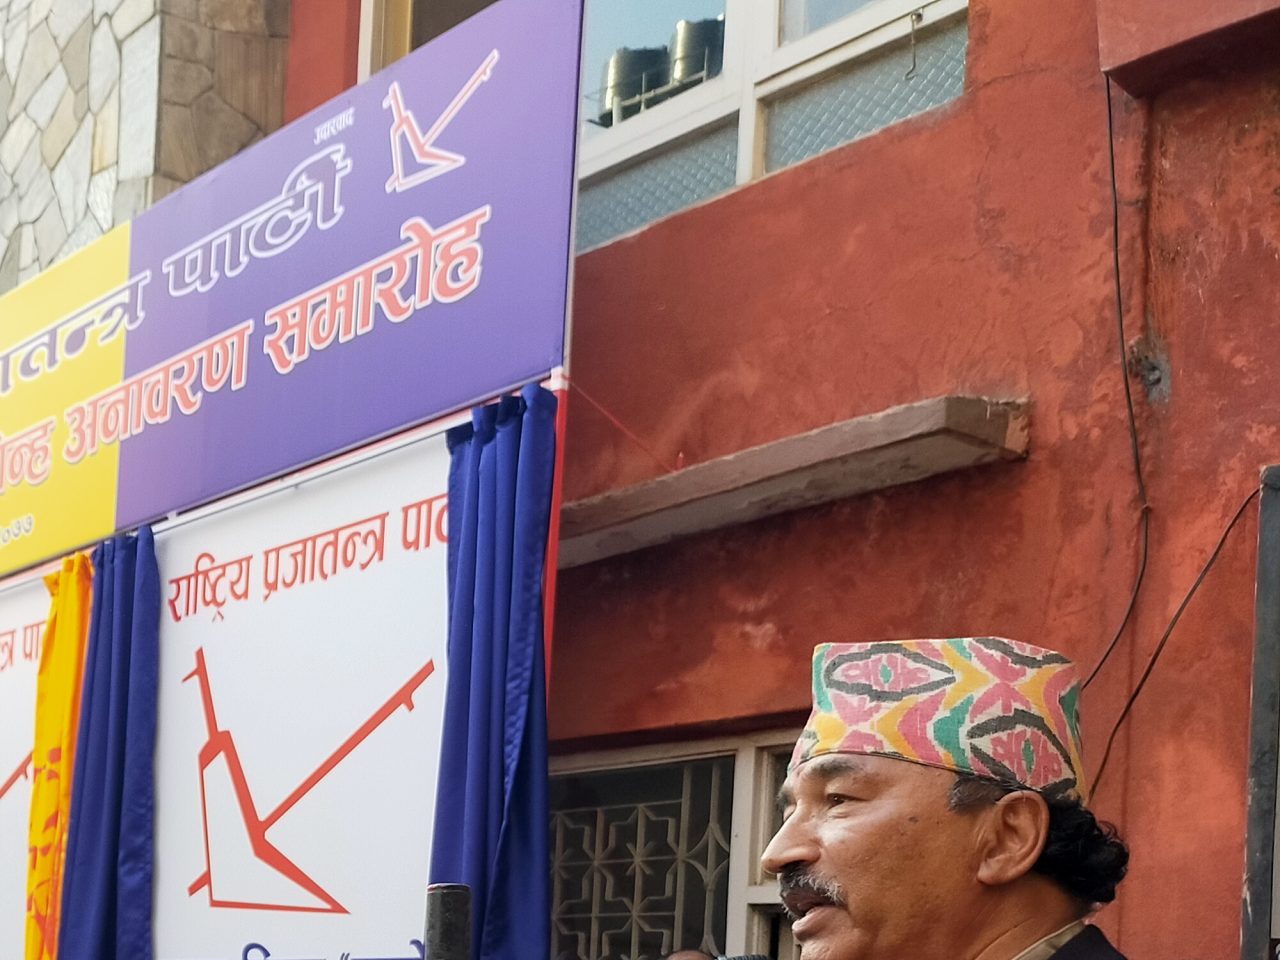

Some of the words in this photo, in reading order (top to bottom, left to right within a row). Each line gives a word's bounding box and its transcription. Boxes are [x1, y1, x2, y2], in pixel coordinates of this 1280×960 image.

[162, 142, 352, 296] पार्टी
[63, 319, 254, 463] अनावरण
[264, 204, 492, 374] समारोह
[168, 552, 253, 623] राष्ट्रिय
[263, 511, 390, 602] प्रजातन्त्र
[23, 620, 47, 661] पा
